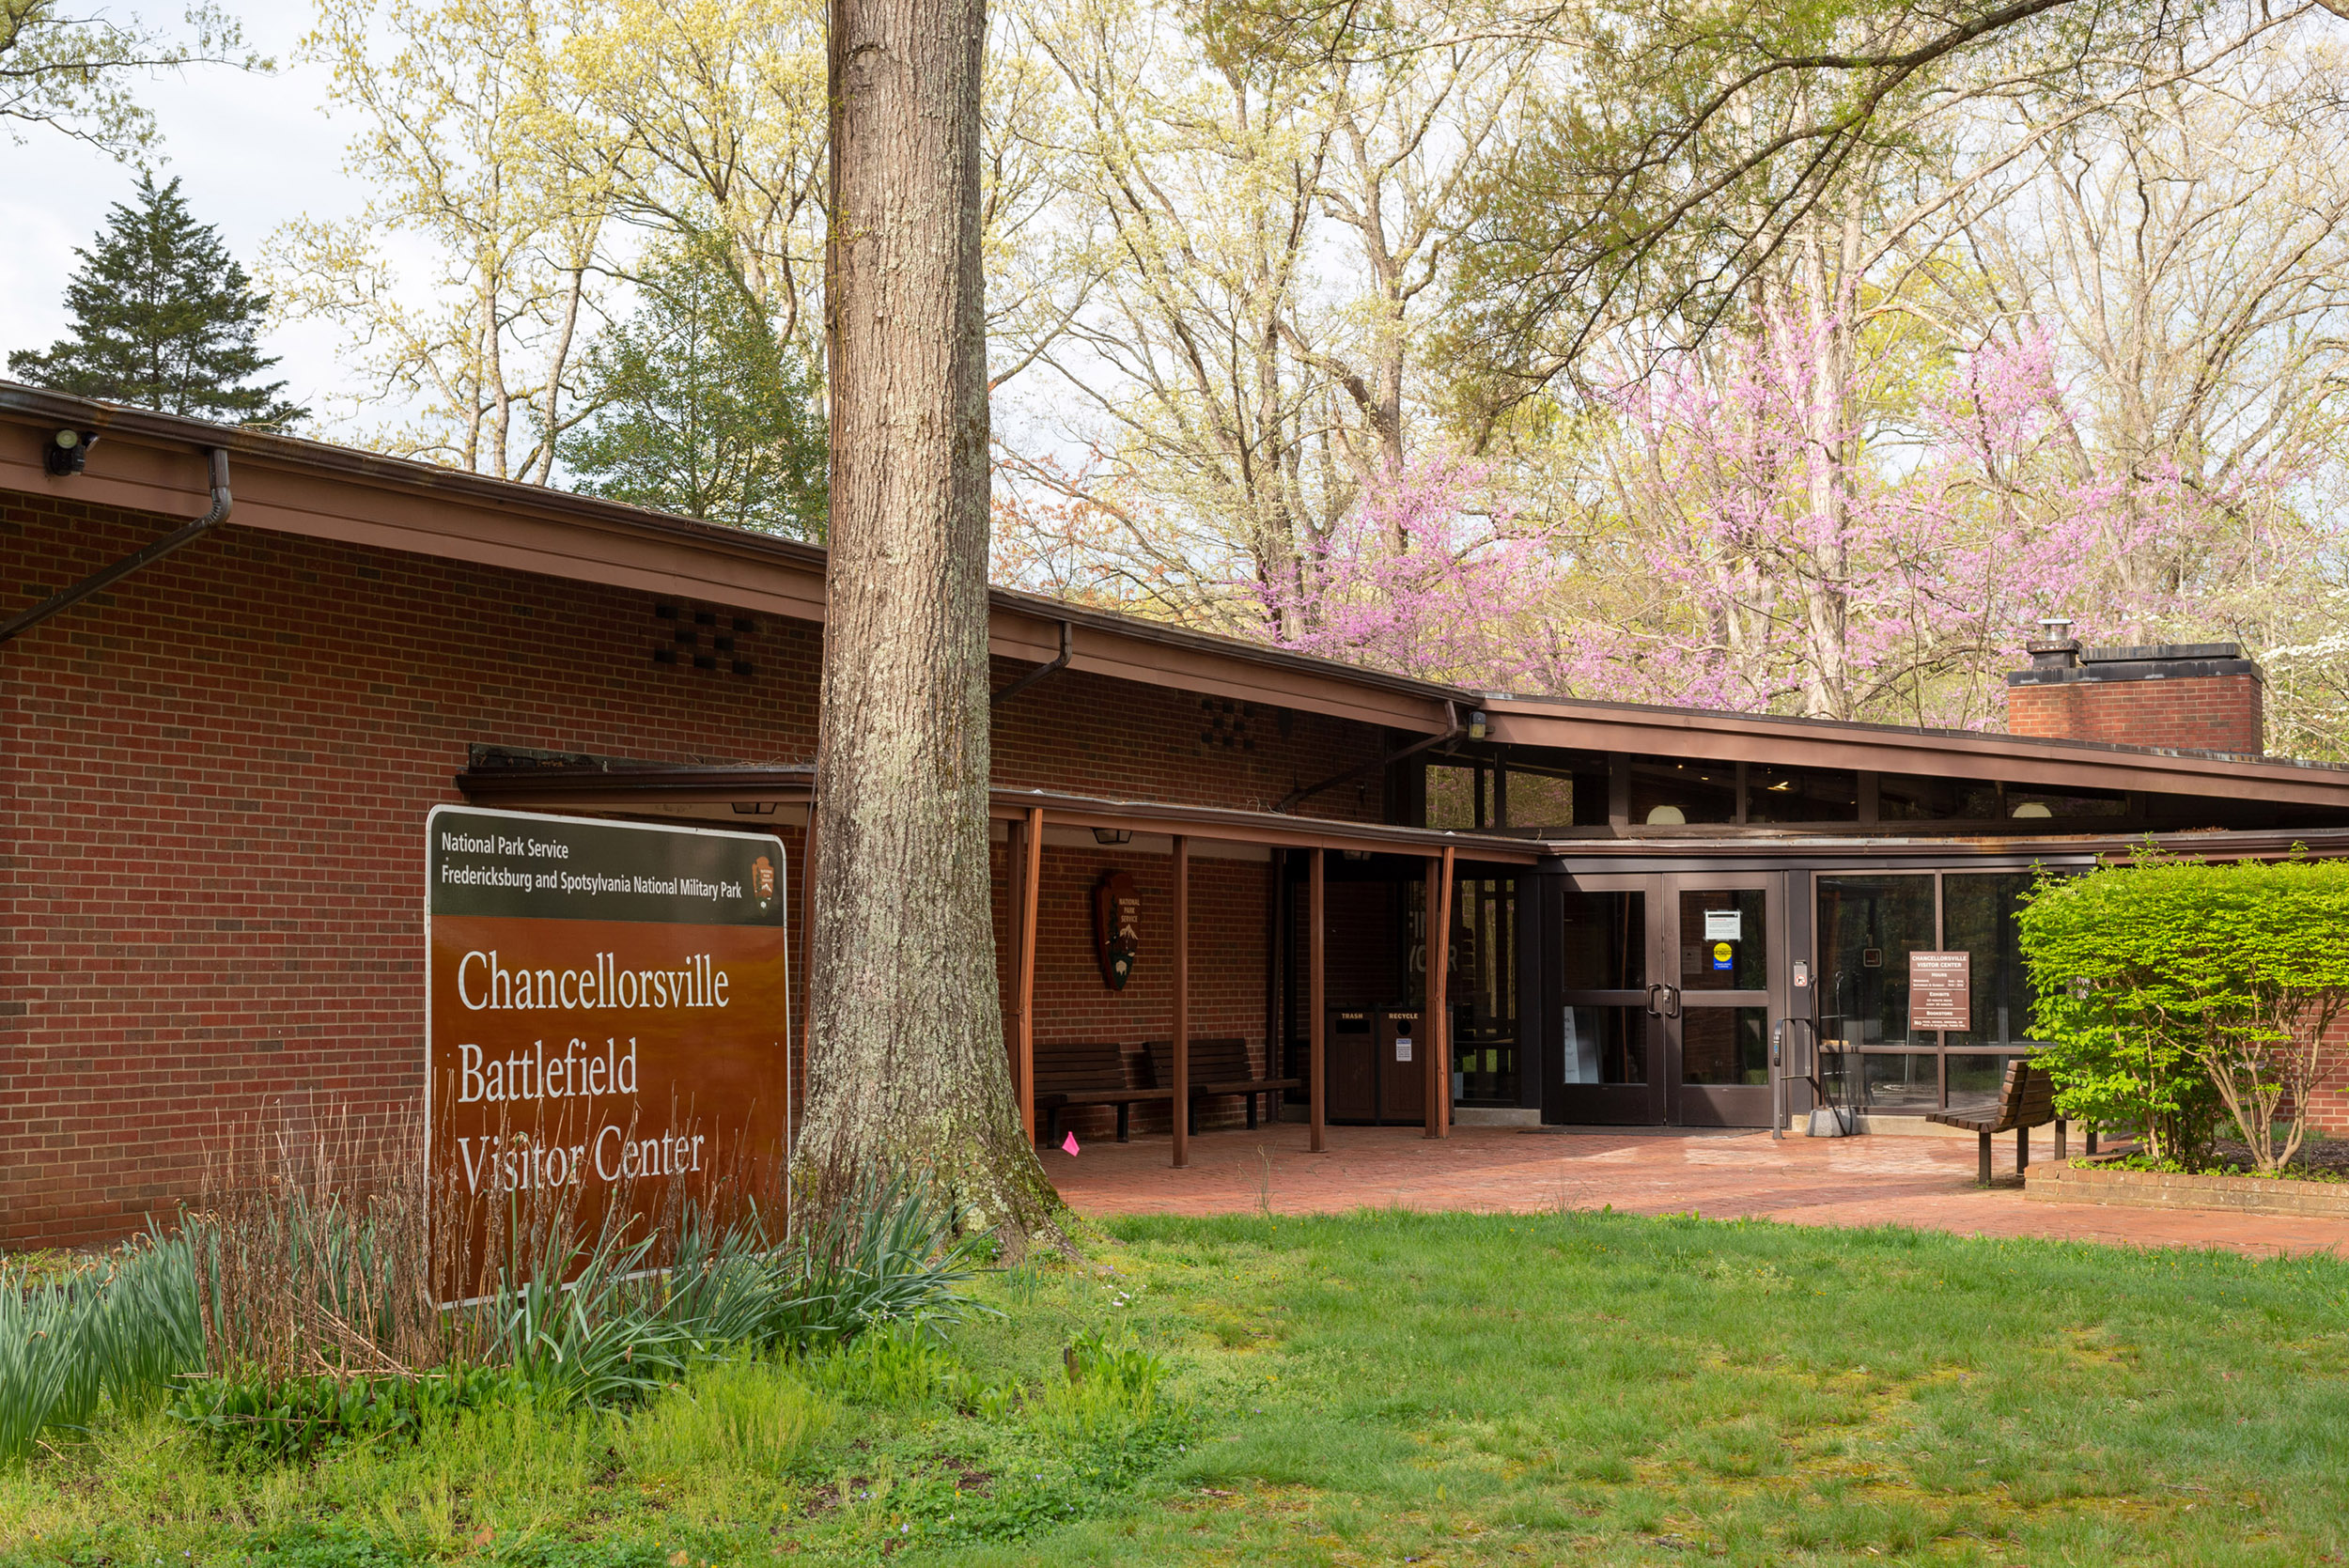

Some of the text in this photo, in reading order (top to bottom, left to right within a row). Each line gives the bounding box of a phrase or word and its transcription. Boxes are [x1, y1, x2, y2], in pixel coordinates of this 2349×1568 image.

[442, 831, 568, 859] National Park Service
[442, 864, 742, 901] Fredericksburg and Spotsylvania National Military Park
[458, 950, 729, 1010] Chancellorsville
[458, 1036, 638, 1103] Battlefield
[458, 1126, 705, 1196] Visitor Center
